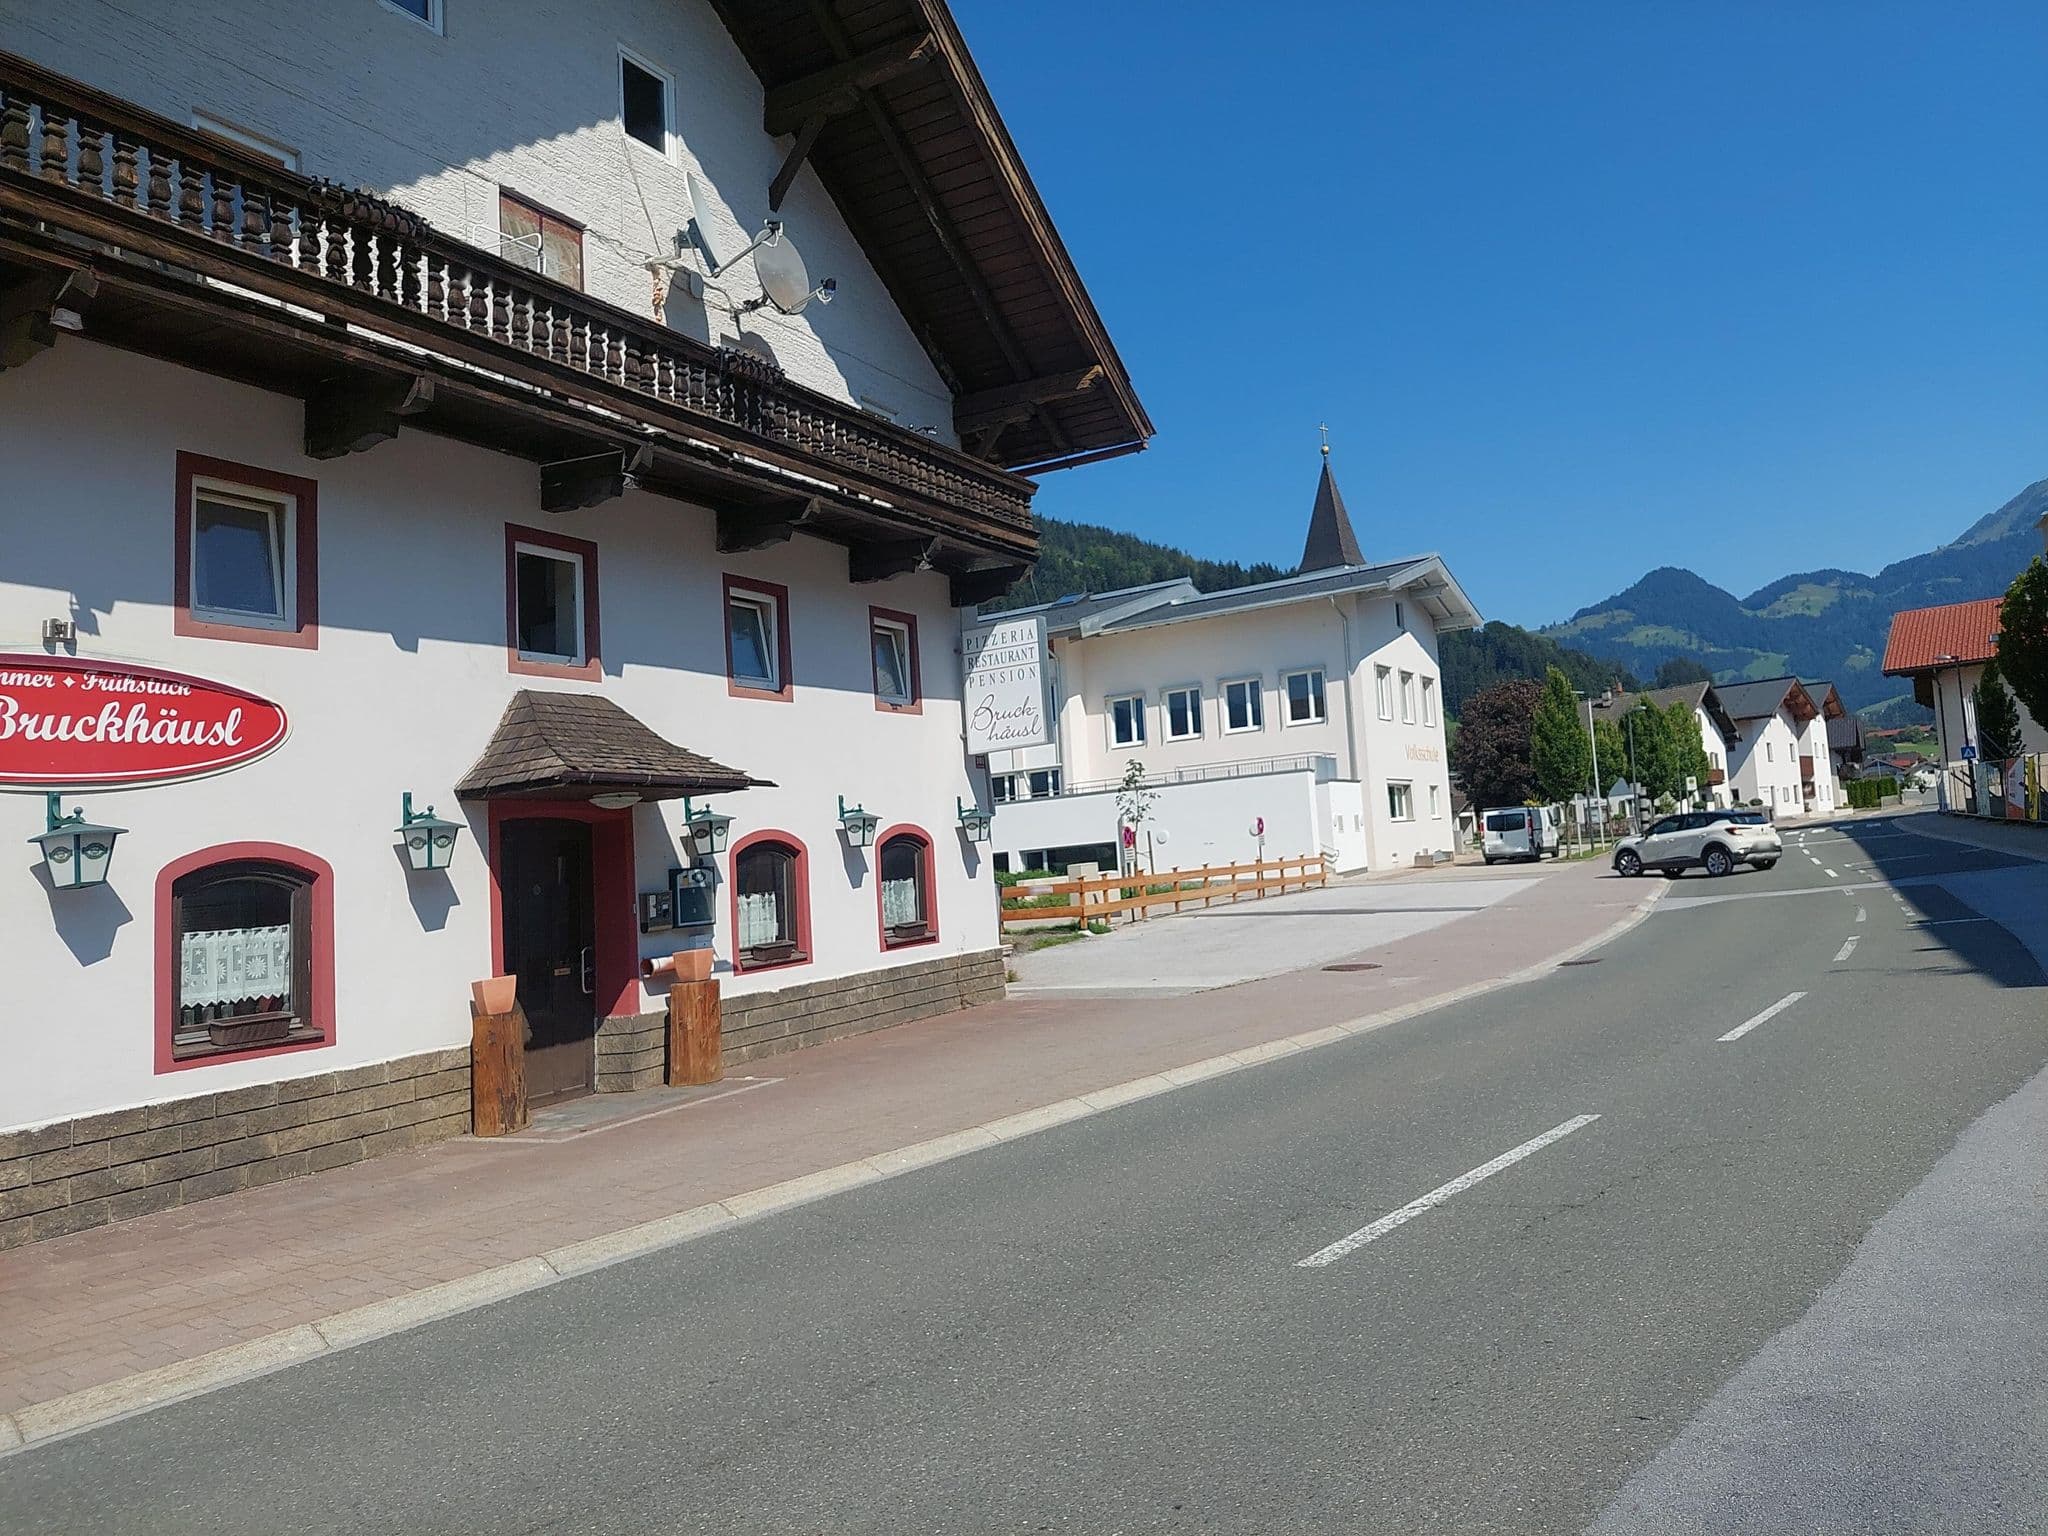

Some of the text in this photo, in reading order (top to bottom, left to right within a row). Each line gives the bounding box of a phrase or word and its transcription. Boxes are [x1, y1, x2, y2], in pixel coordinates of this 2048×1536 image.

[966, 627, 1035, 650] PIZZERIA
[968, 646, 1035, 669] RESTAURANT
[80, 670, 192, 697] Frühstück
[969, 666, 1037, 688] PENSION
[0, 694, 243, 747] Bruckhäusl
[970, 693, 1037, 731] Bruck-
[987, 714, 1042, 741] häusl
